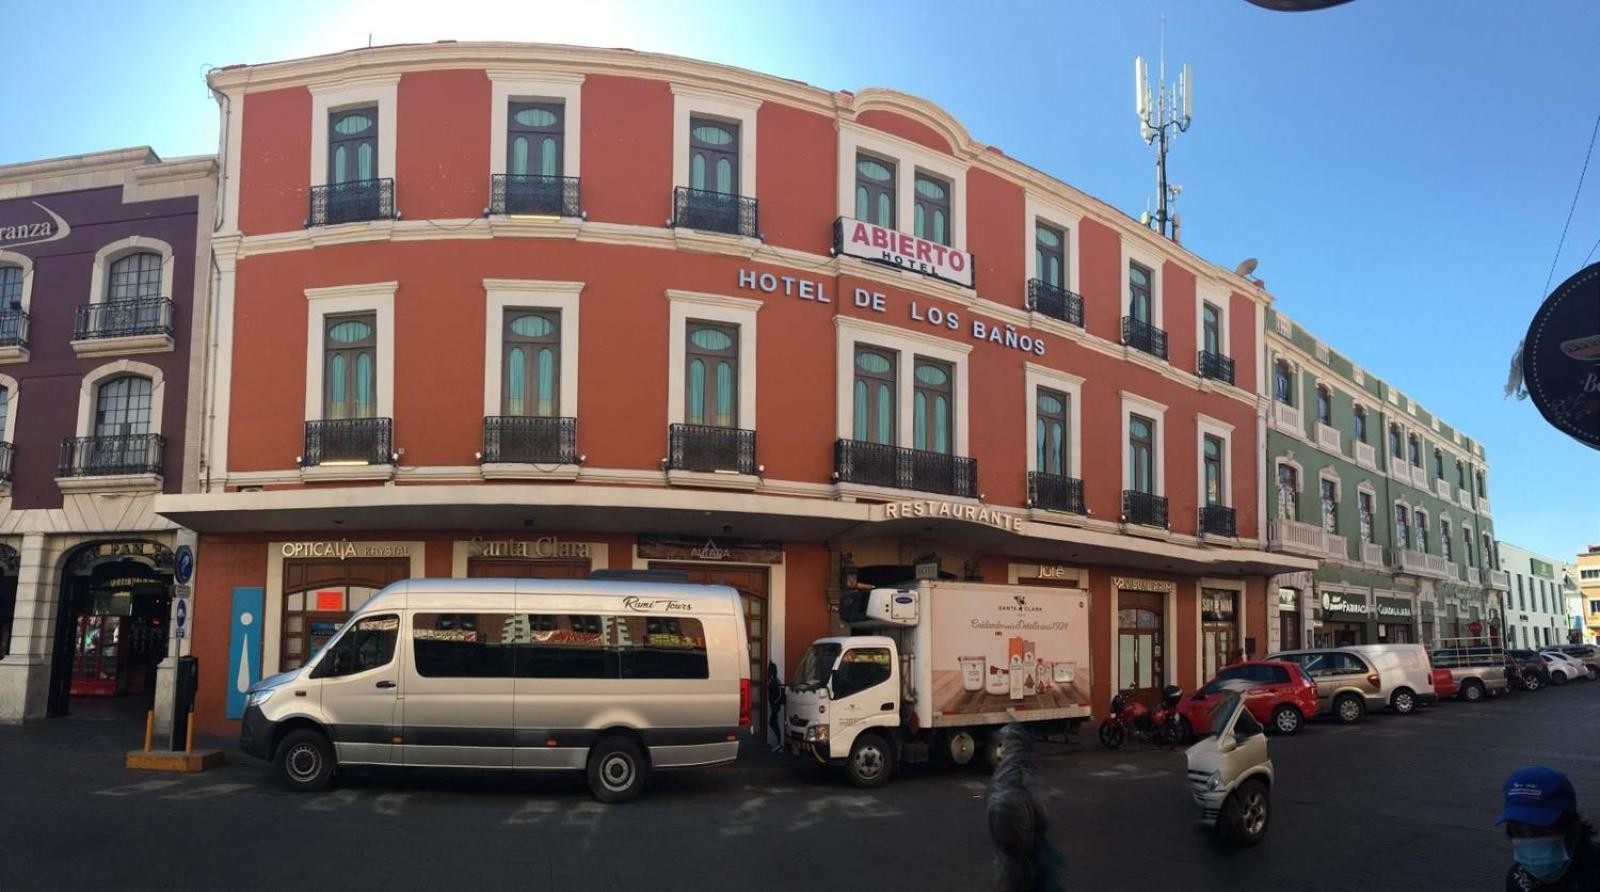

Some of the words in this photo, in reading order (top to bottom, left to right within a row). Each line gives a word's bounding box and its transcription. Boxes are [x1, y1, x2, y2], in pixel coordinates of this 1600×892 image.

[851, 222, 965, 273] ABIERTO
[882, 250, 939, 277] HOTEL
[738, 268, 831, 303] HOTEL
[854, 288, 887, 312] DE
[910, 301, 959, 330] LOS
[972, 321, 1045, 356] BAÑOS
[886, 501, 1024, 531] RESTAURANTE
[468, 536, 528, 557] Santa
[535, 537, 590, 558] Clara
[655, 599, 693, 612] Tours
